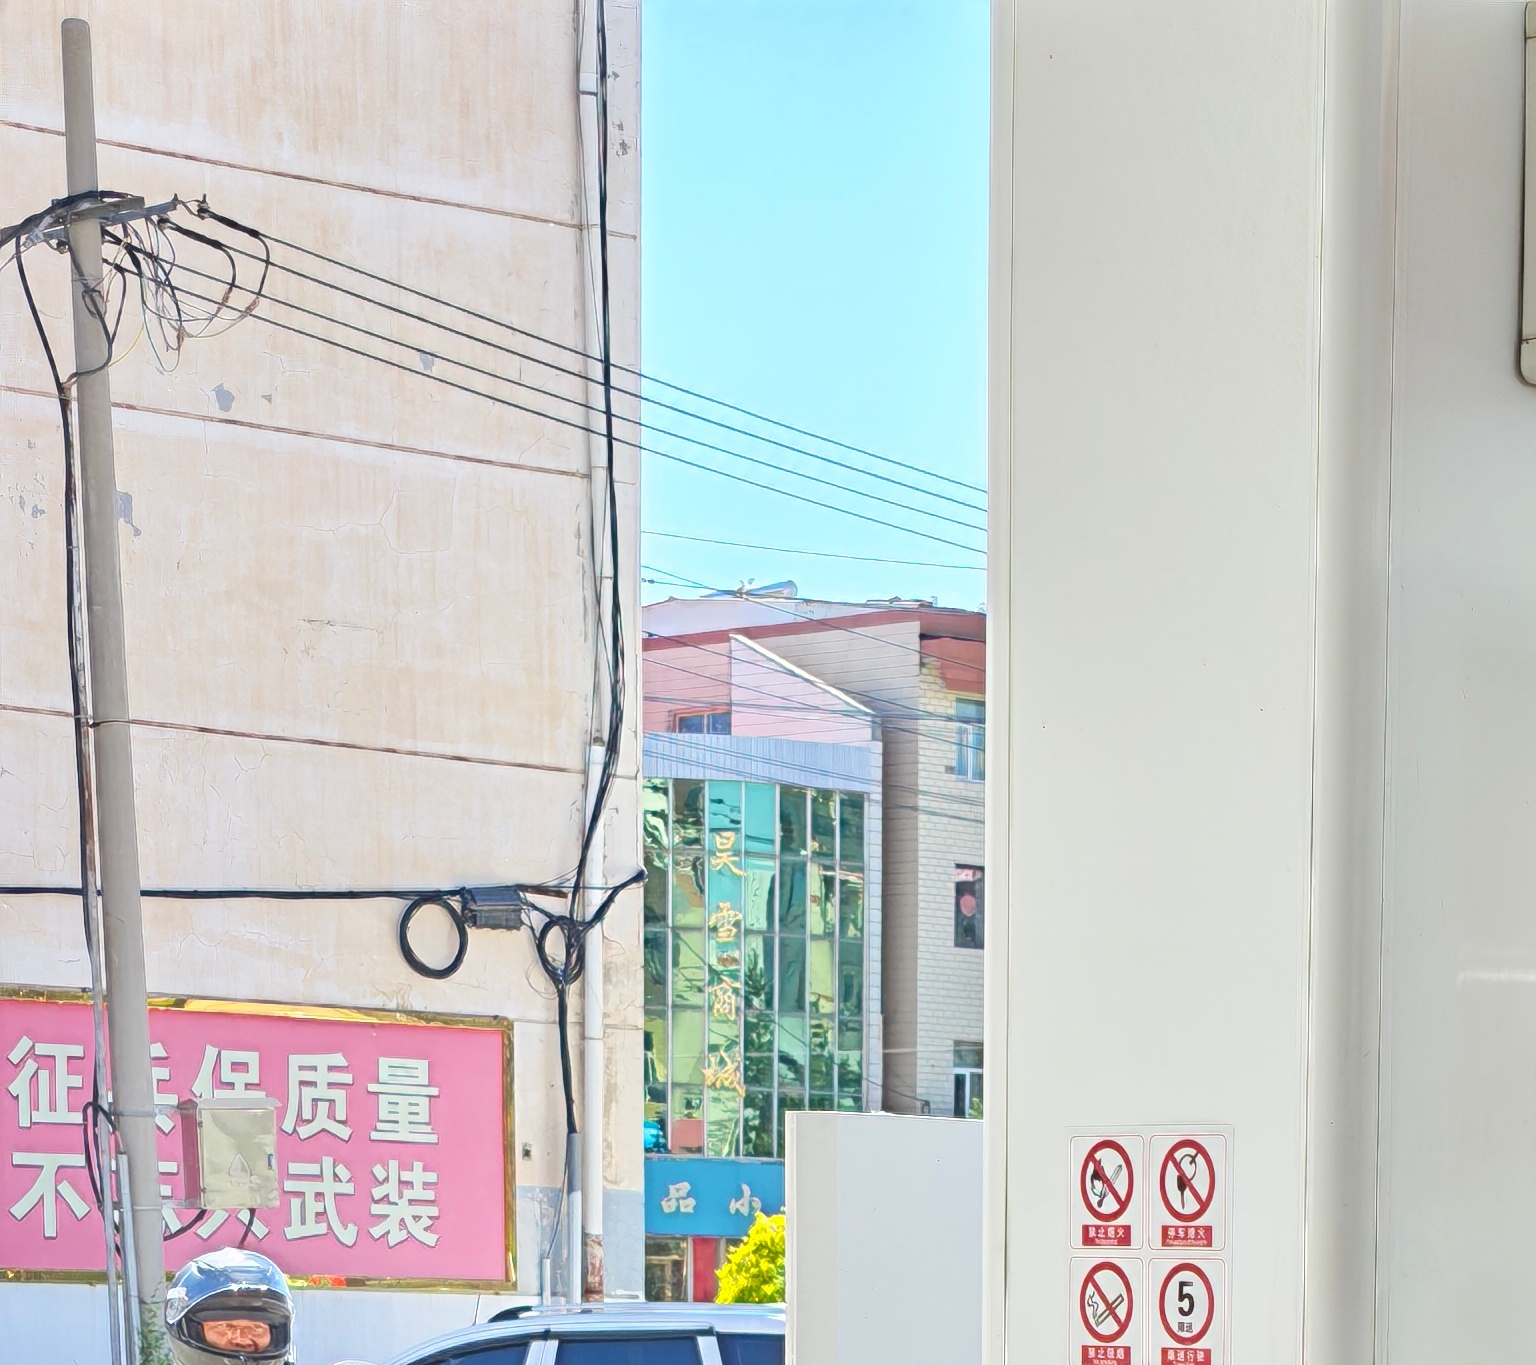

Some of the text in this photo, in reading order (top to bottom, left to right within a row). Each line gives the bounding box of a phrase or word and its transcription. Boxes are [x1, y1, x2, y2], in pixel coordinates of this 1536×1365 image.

[10, 1151, 440, 1249] 不武装
[1177, 1281, 1195, 1317] 5
